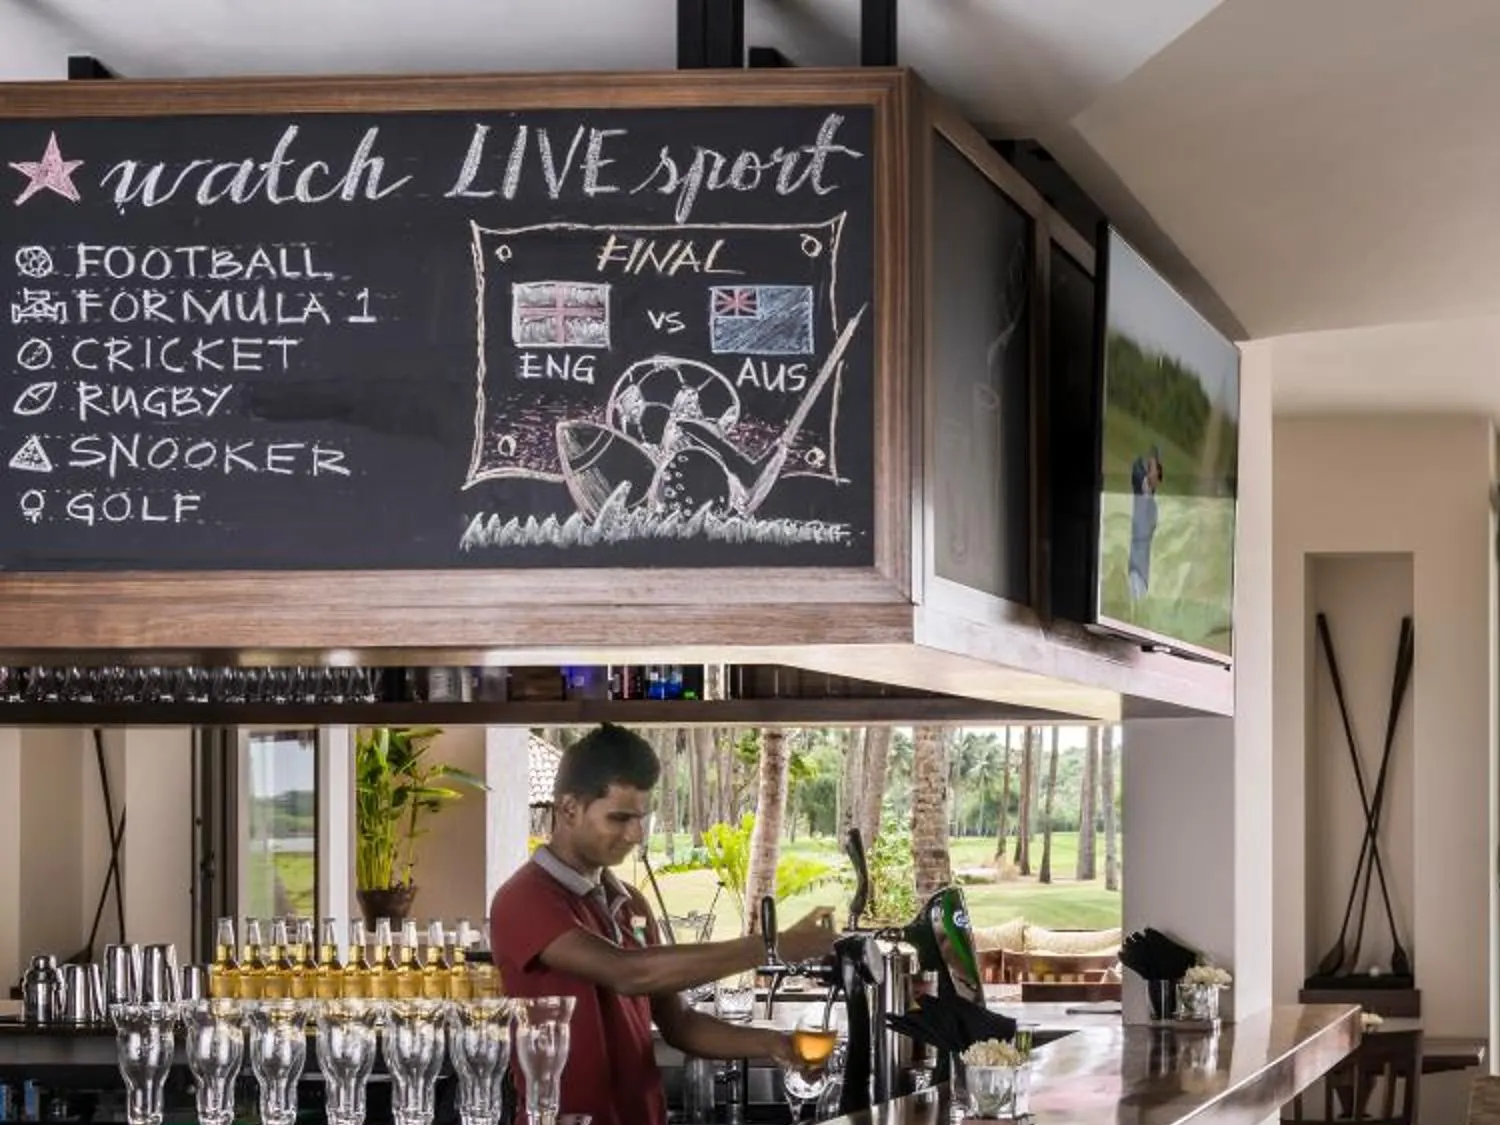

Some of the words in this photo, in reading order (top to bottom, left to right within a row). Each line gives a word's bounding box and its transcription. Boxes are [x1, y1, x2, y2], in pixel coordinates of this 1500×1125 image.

[100, 125, 413, 207] watch
[444, 123, 628, 200] LIVE
[630, 113, 864, 224] sport
[76, 242, 334, 280] FOOTBALL
[597, 234, 746, 276] FINAL
[76, 287, 331, 324] FORMULA
[348, 287, 377, 322] 1
[71, 337, 303, 372] CRICKET
[519, 353, 597, 384] ENG
[736, 357, 808, 392] AUS
[77, 380, 233, 421] RUGBY
[69, 434, 351, 478] SNOOKER
[67, 492, 201, 526] GOLF
